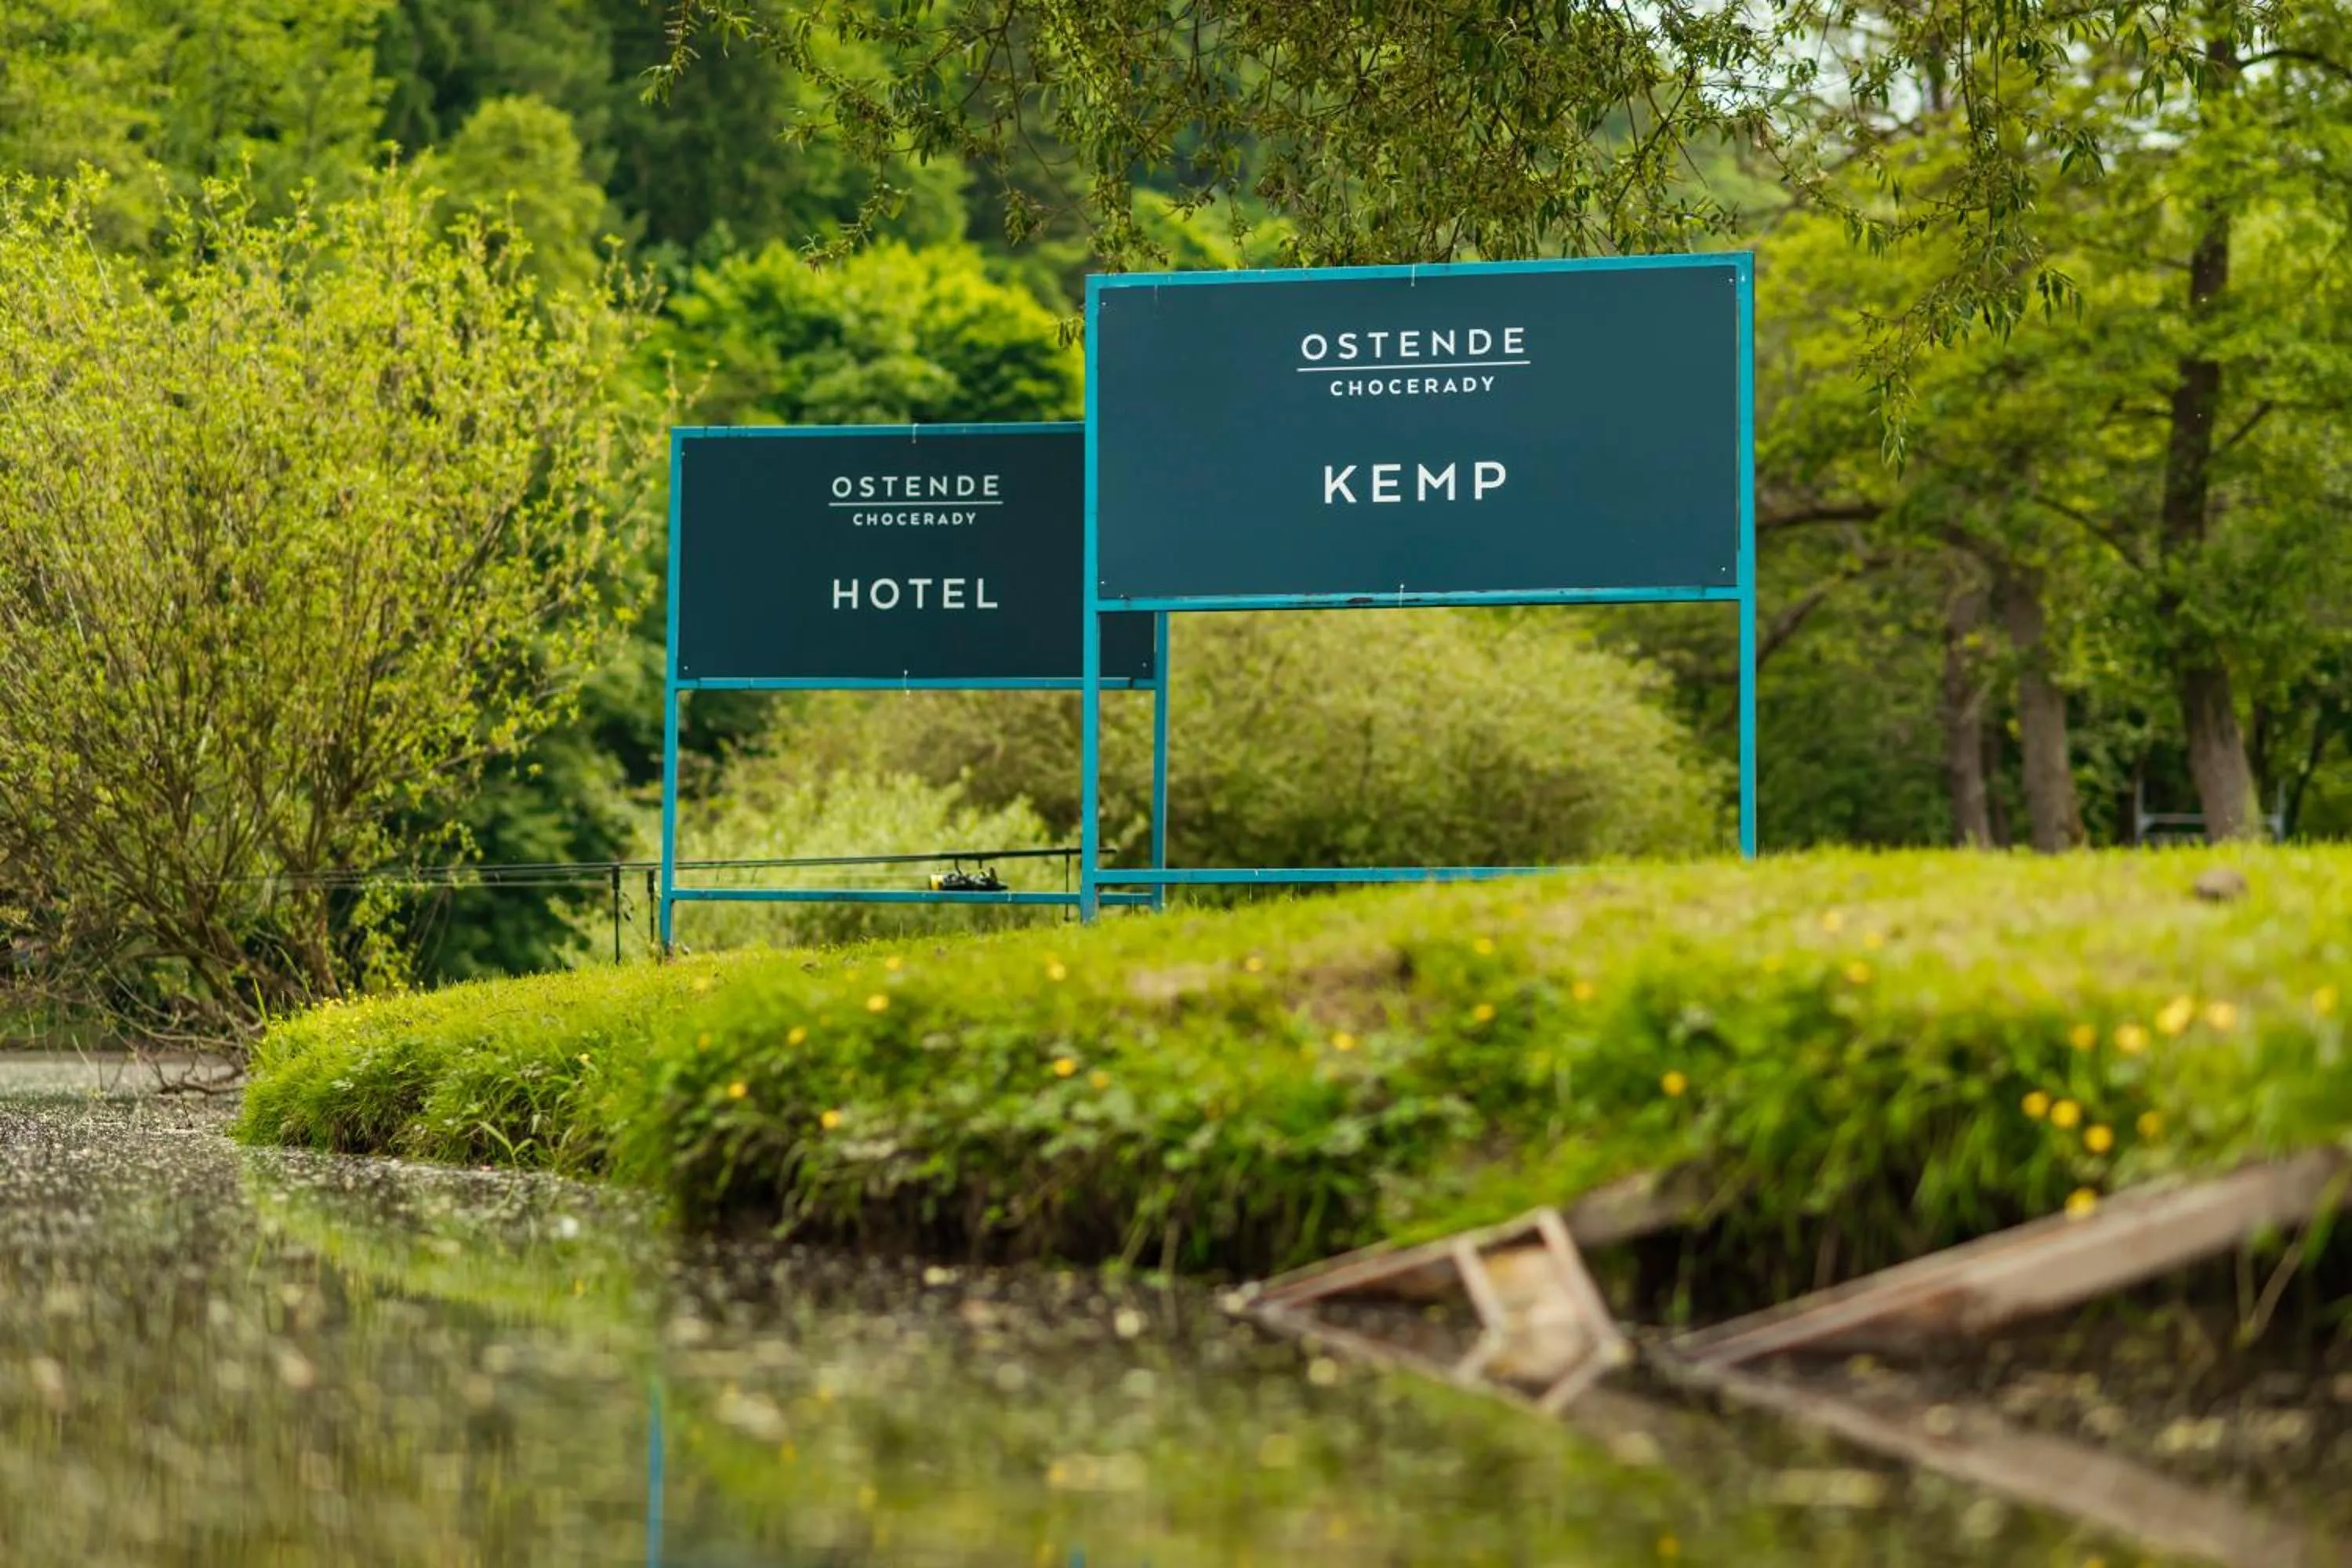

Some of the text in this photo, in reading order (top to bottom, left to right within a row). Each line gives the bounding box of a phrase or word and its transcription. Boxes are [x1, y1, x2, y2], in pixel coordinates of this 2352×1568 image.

[1301, 327, 1524, 361] OSTENDE
[1330, 376, 1494, 396] CHOCERADY
[832, 475, 1000, 497] OSTENDE
[1324, 461, 1506, 504] KEMP
[853, 513, 976, 525] CHOCERADY
[833, 578, 998, 609] HOTEL
